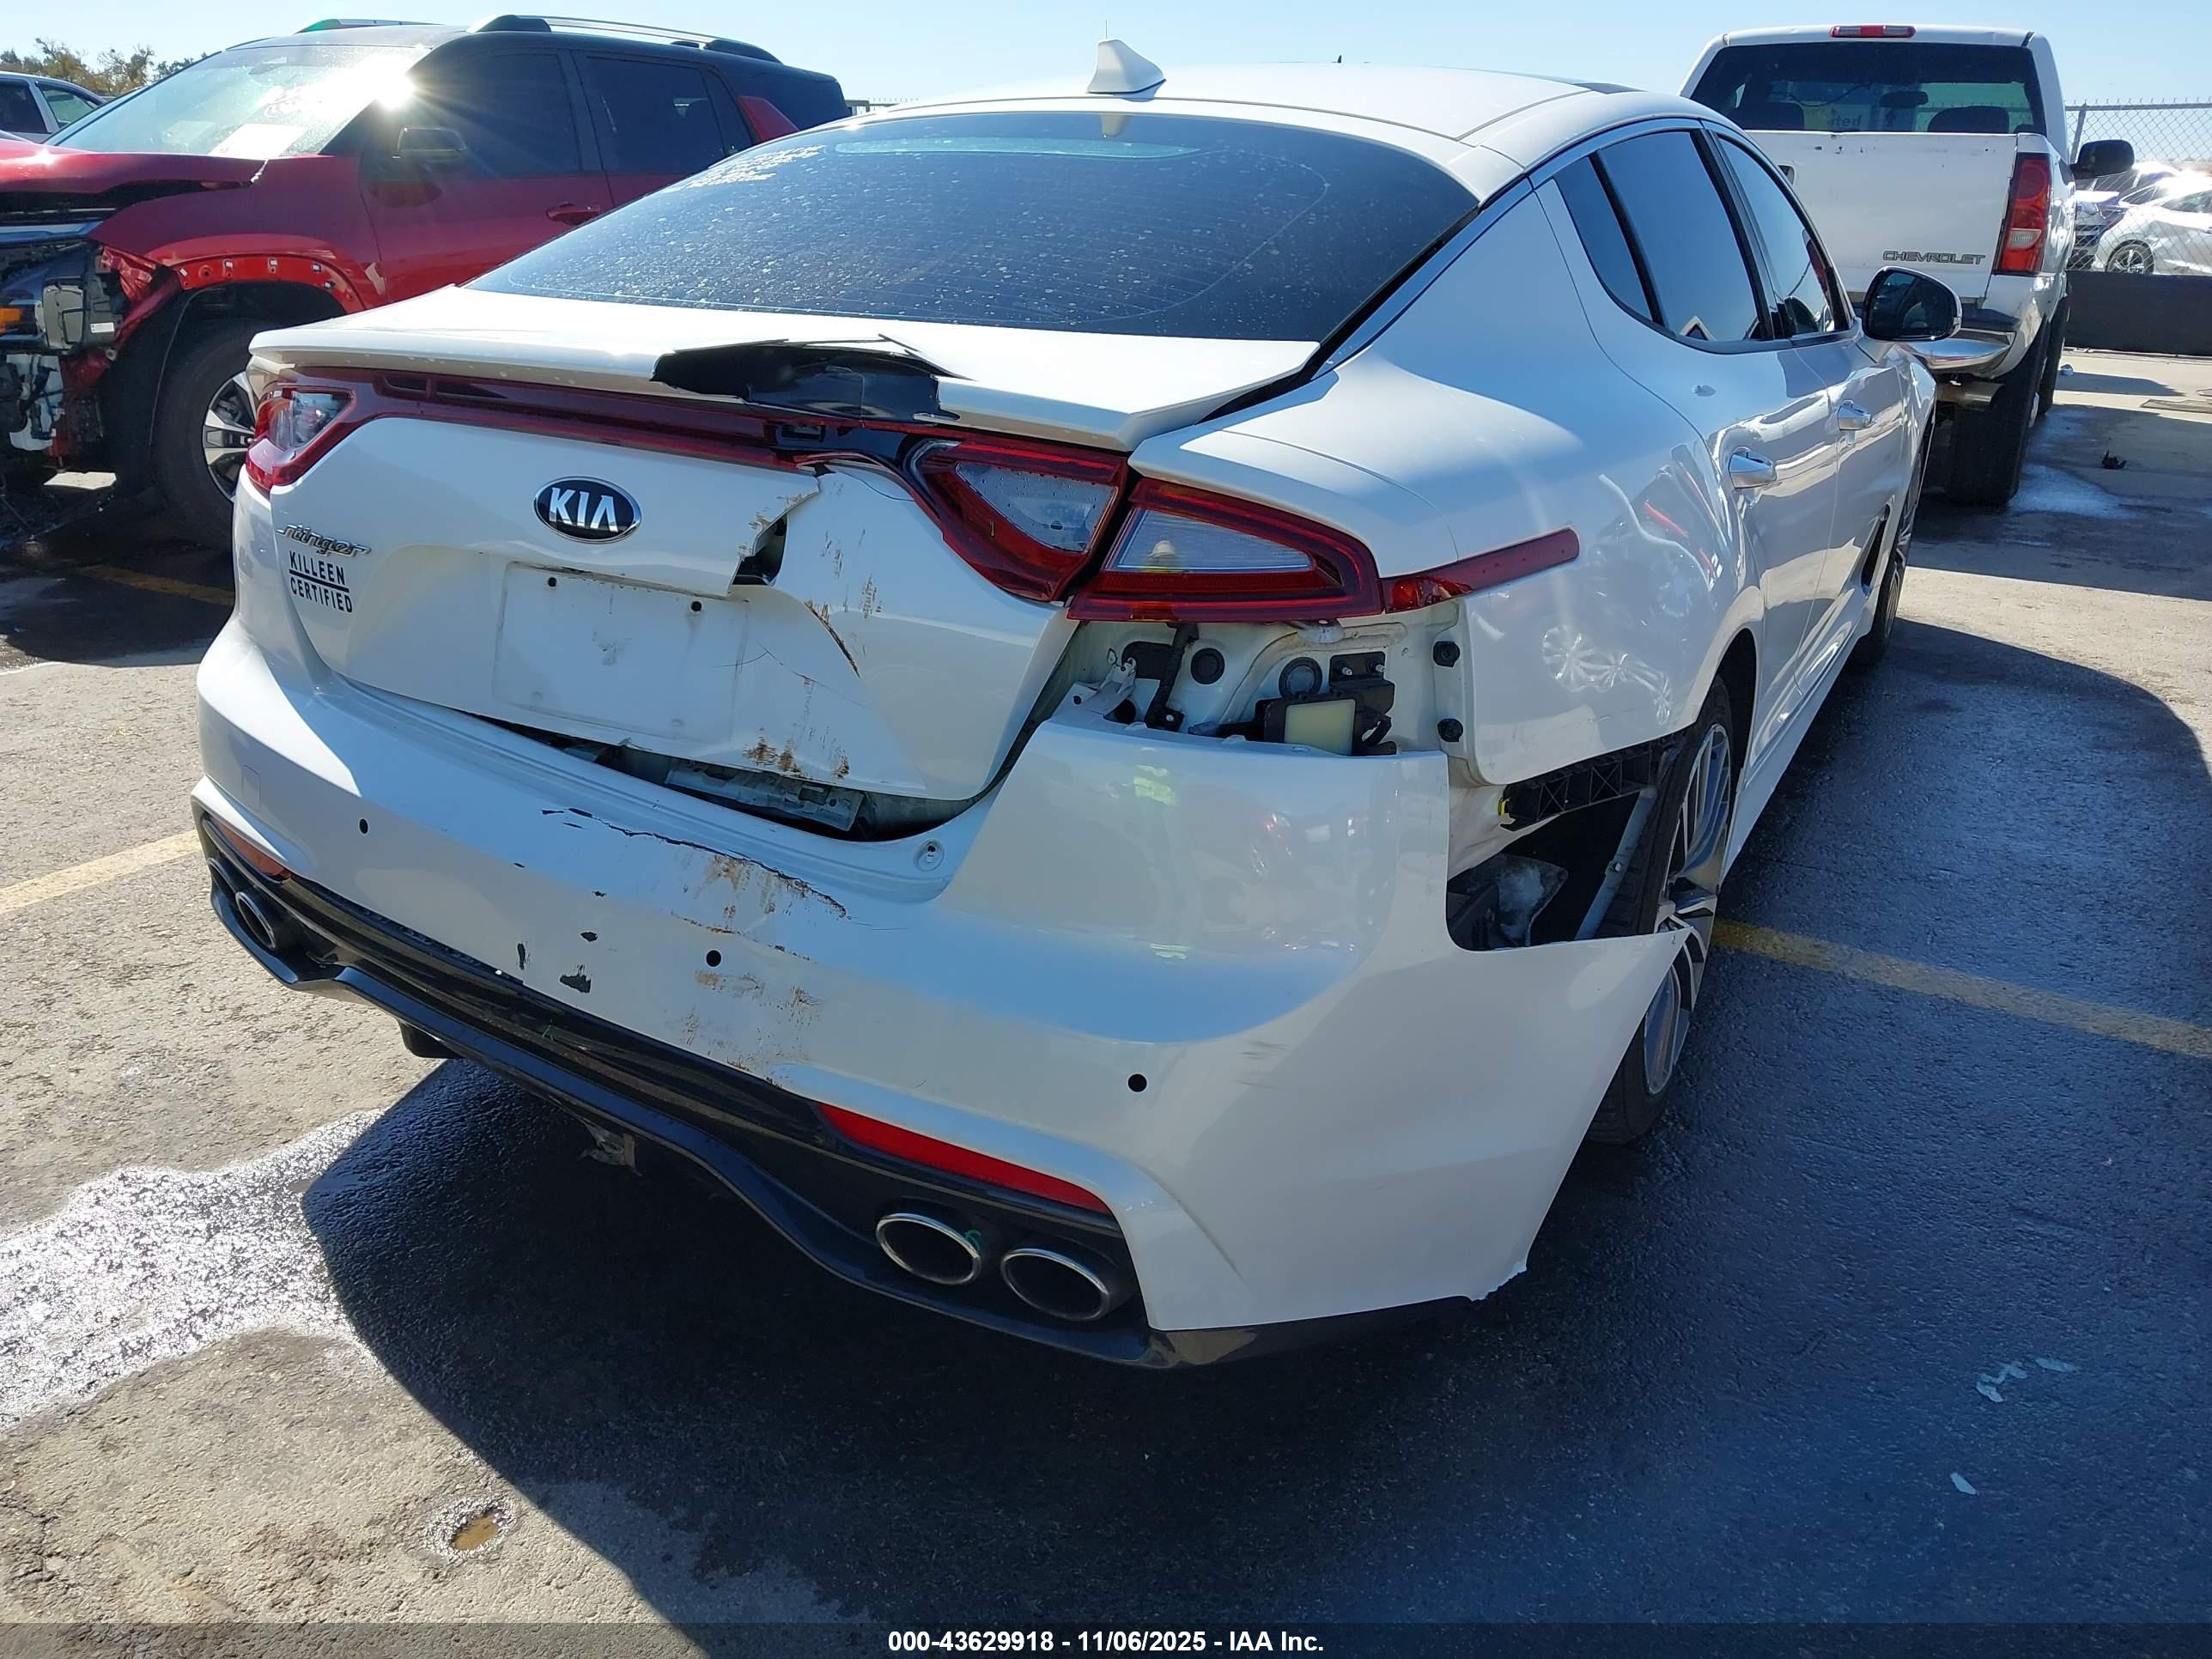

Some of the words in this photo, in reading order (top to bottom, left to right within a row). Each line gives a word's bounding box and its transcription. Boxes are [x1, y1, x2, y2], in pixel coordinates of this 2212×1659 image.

[1882, 250, 1986, 265] CHEVROLET
[549, 487, 618, 533] KIA
[289, 550, 346, 586] KILLEEN
[290, 576, 354, 614] CERTIFIED
